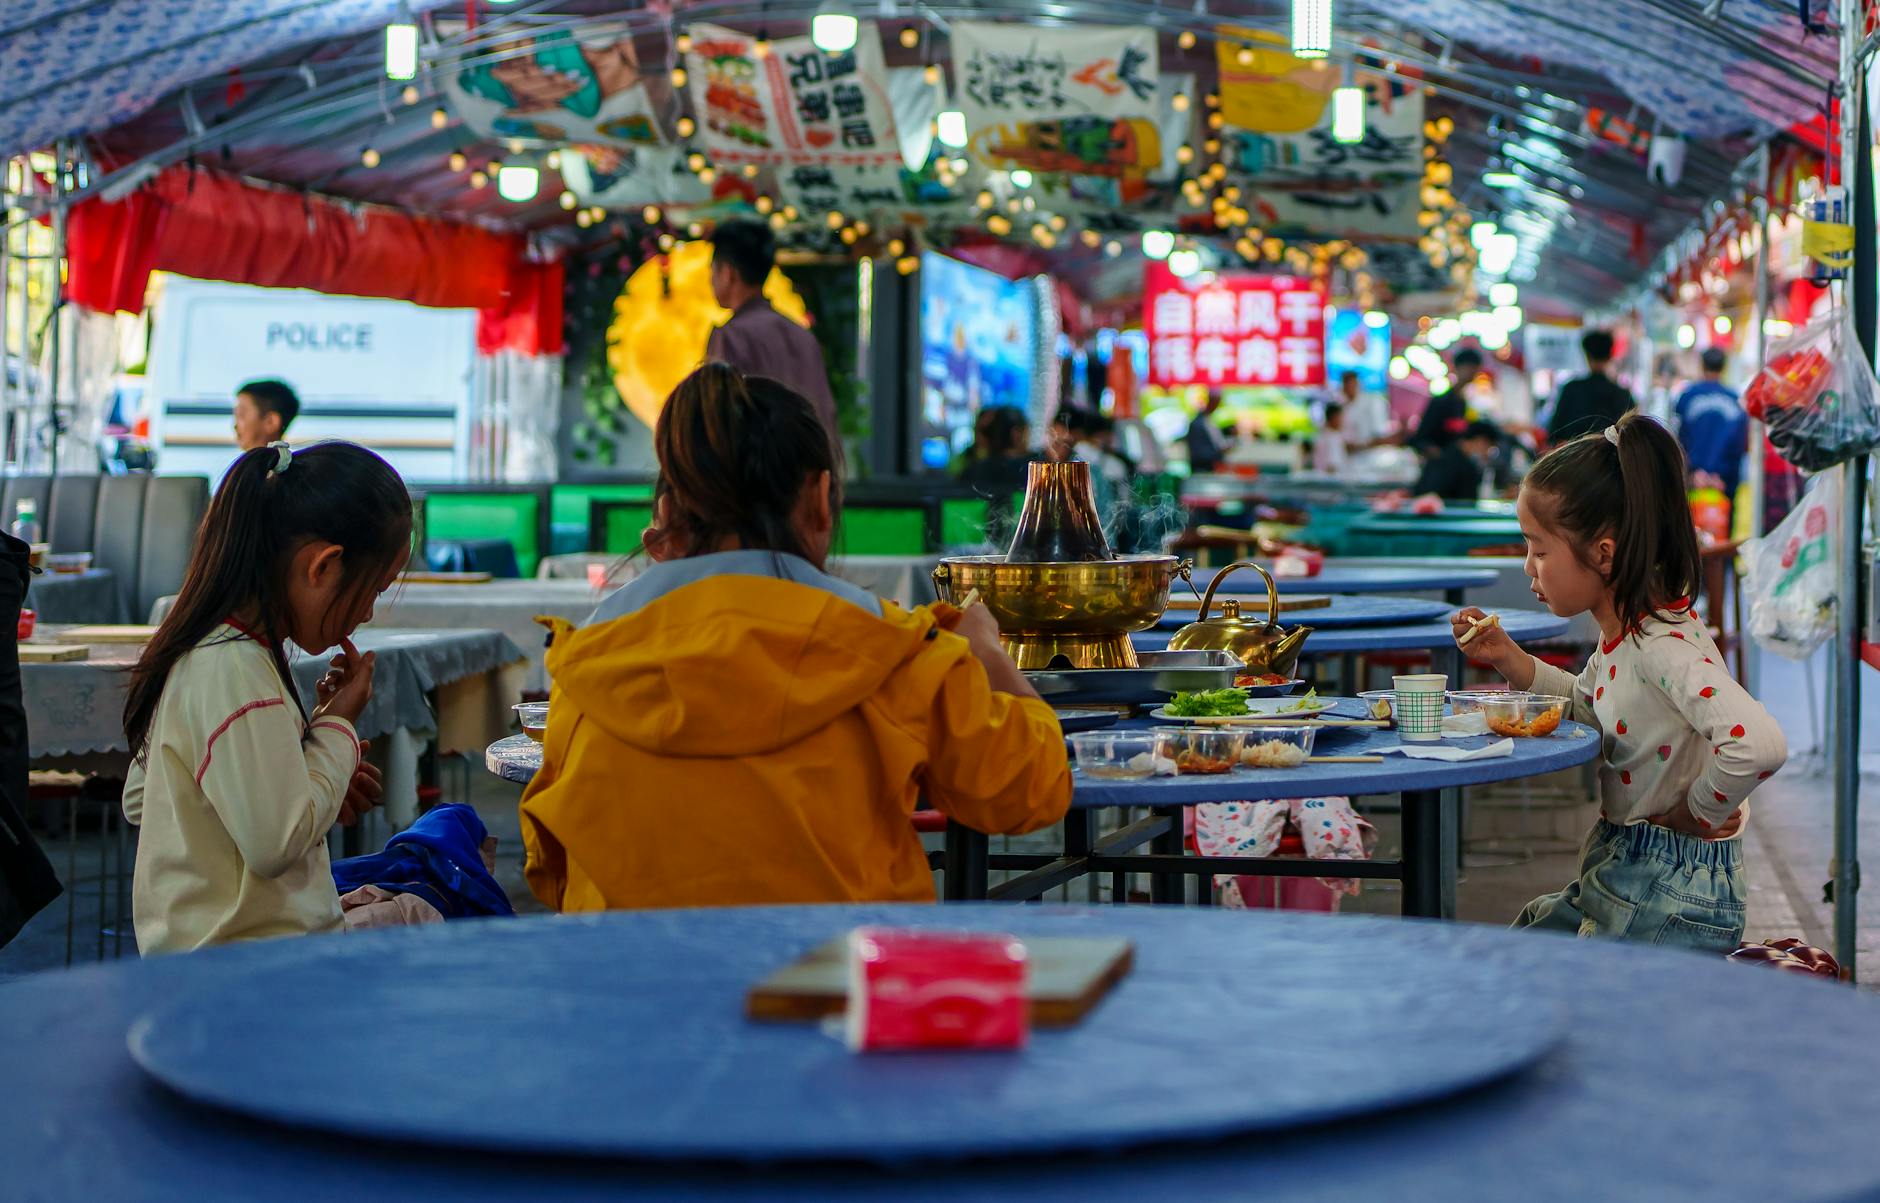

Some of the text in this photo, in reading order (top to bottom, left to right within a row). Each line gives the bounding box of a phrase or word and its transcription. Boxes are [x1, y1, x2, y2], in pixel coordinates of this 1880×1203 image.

[1154, 289, 1321, 335] 自然风干
[266, 321, 373, 352] POLICE
